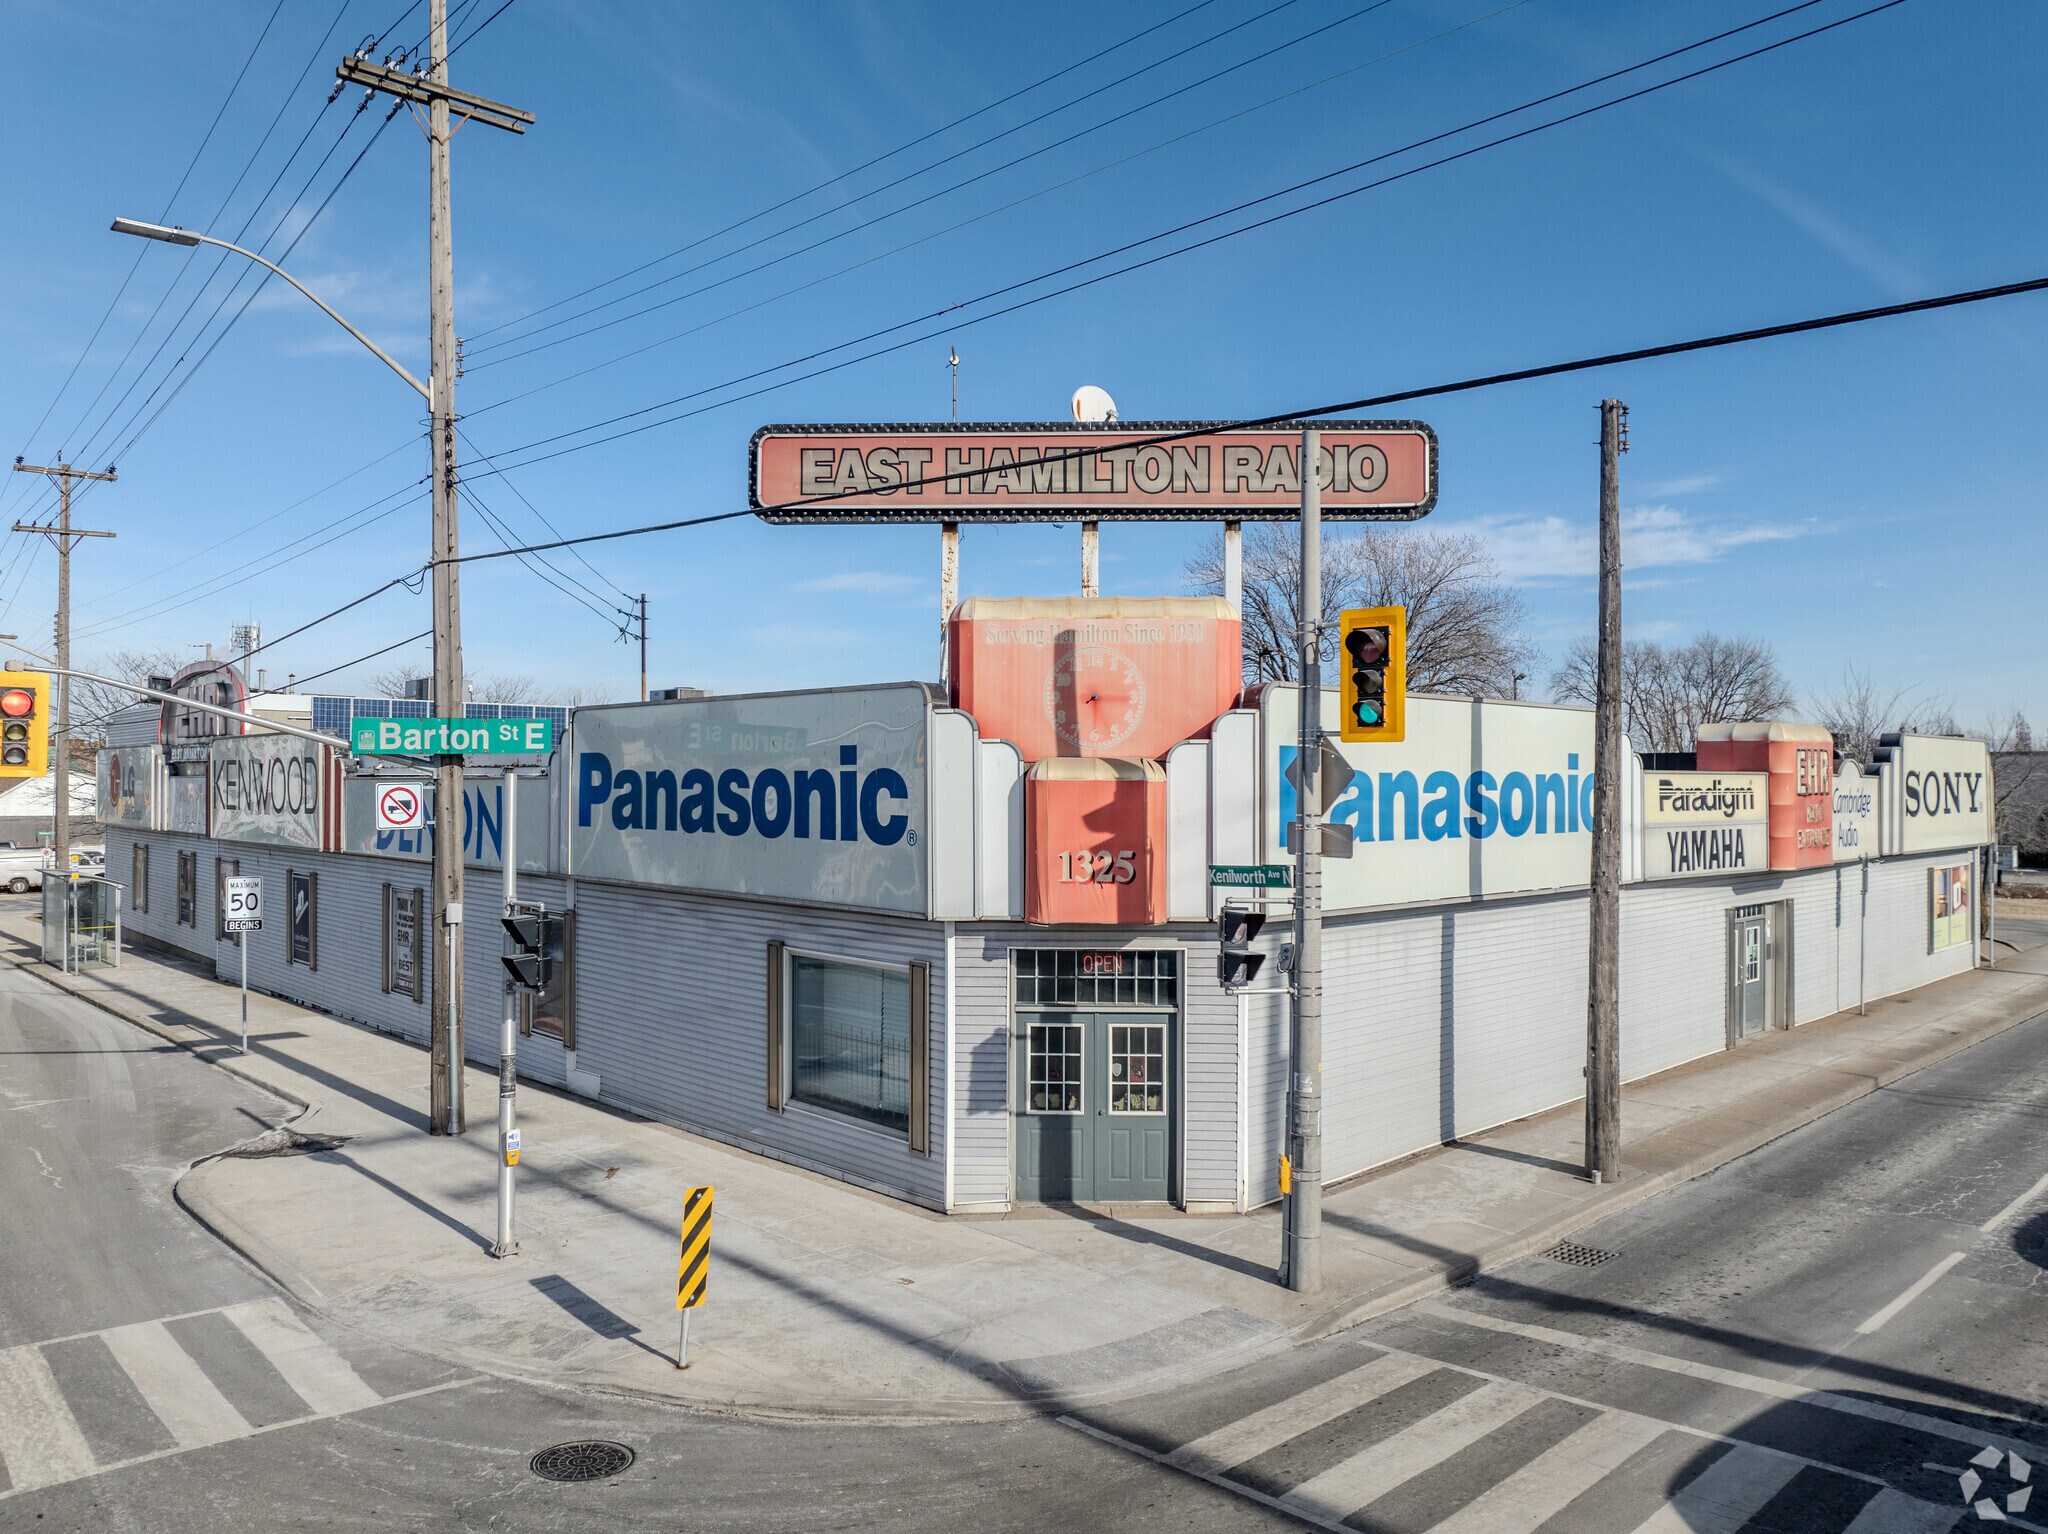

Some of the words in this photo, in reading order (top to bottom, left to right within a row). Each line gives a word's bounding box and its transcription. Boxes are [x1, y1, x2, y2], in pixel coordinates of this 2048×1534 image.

[800, 447, 933, 496] EAST
[945, 445, 1211, 495] HAMILTON
[986, 625, 1045, 648] Serving
[1050, 624, 1120, 643] Hamilton
[1124, 624, 1165, 643] Since
[1169, 623, 1204, 643] 1931
[1070, 658, 1083, 672] 11
[1088, 653, 1104, 667] 12
[1110, 657, 1118, 671] 1
[1056, 673, 1071, 687] 10
[1124, 671, 1135, 685] 2
[1051, 692, 1061, 704] 9
[1129, 691, 1139, 704] 3
[1056, 710, 1066, 724] 8
[1123, 710, 1134, 723] 4
[380, 722, 489, 750] Barton
[500, 724, 519, 741] St
[526, 723, 545, 750] E
[1071, 724, 1080, 737] 7
[1089, 728, 1099, 742] 6
[1110, 724, 1120, 737] 5
[122, 765, 135, 798] LG
[1797, 749, 1829, 797] EHR
[213, 756, 318, 815] KENWOOD
[1906, 770, 1982, 817] SONY
[1279, 745, 1595, 848] anasoni
[1659, 779, 1755, 818] Paradigm
[1832, 787, 1871, 818] Cambridge
[1838, 822, 1858, 847] Audio
[1667, 829, 1745, 872] YAMAHA
[1057, 850, 1137, 885] 1325
[230, 881, 259, 889] MAXIMUM
[1209, 868, 1266, 885] Kenilworth
[1267, 871, 1281, 880] Ave
[1283, 871, 1291, 884] N
[231, 892, 259, 912] 50
[229, 920, 260, 930] BEGINS
[1083, 955, 1123, 973] OPEN
